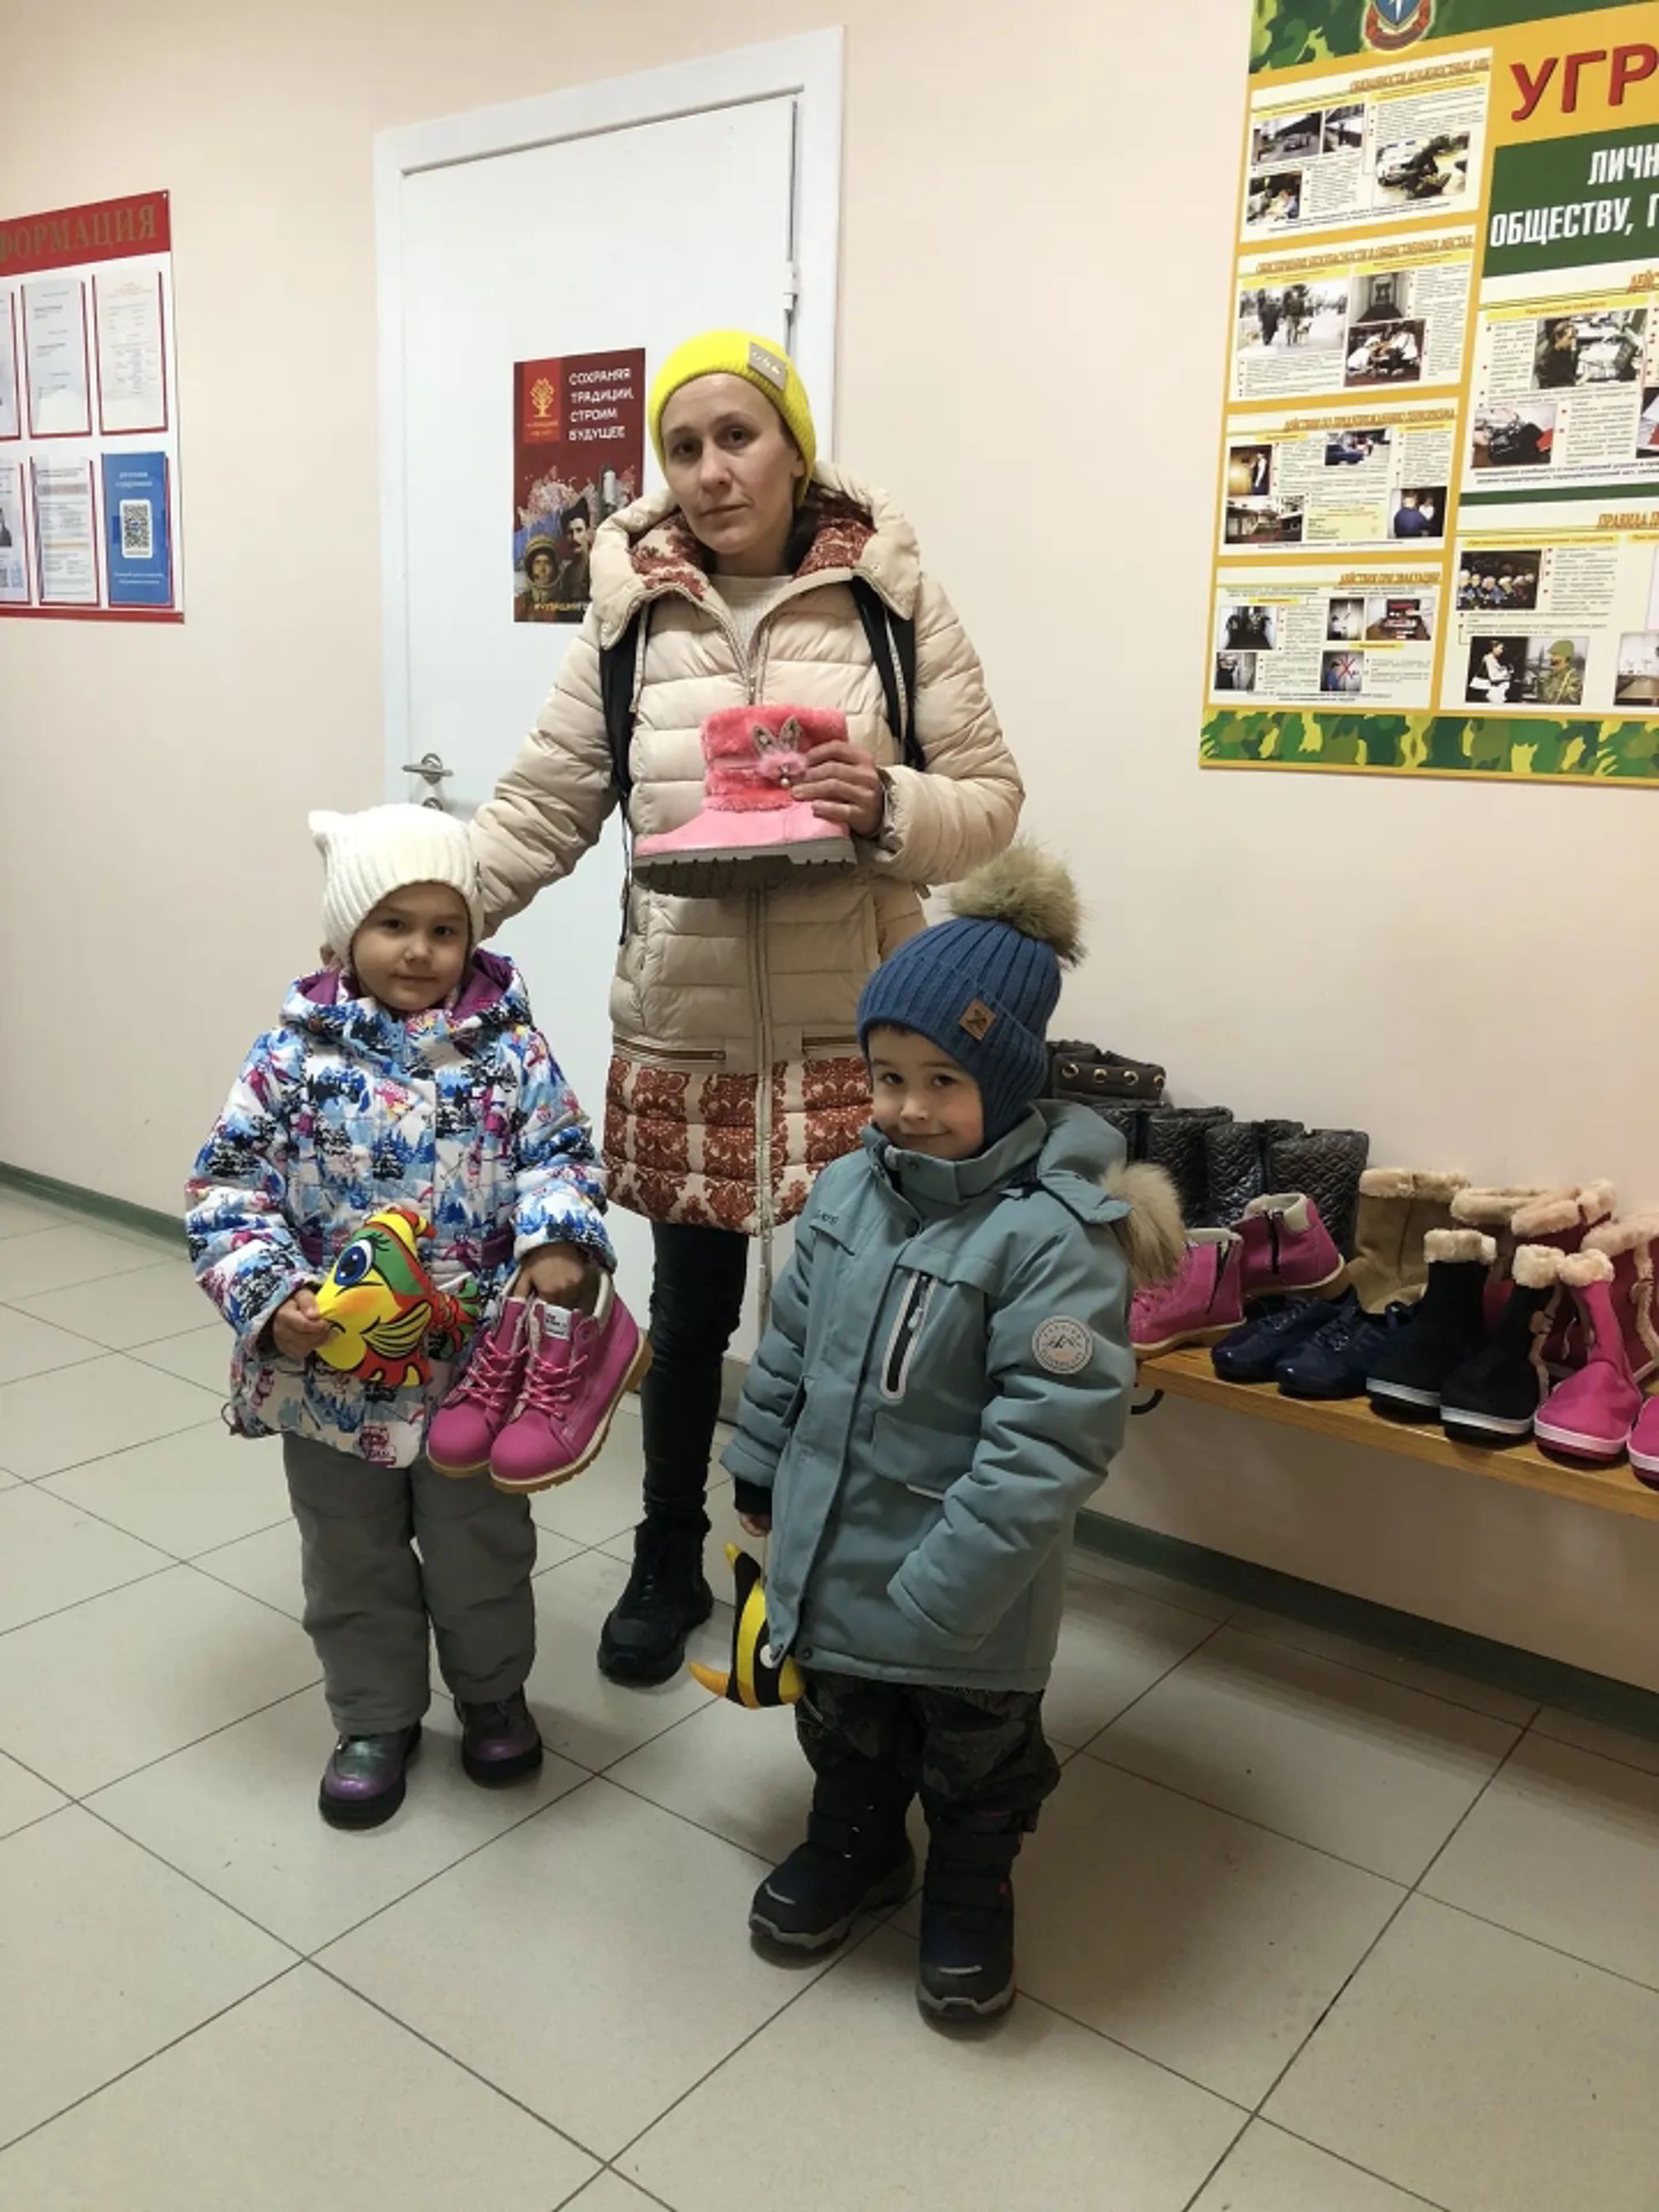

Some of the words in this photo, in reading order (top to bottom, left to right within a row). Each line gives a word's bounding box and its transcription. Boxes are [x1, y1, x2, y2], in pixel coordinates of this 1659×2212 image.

[1510, 44, 1658, 121] УГР
[1587, 142, 1659, 185] ЛИЧН
[1490, 197, 1635, 247] ОБЩЕСТВУ,
[569, 368, 631, 385] СОХРАНЯЯ
[570, 407, 618, 422] СТРОИМ
[568, 425, 625, 442] БУДУЩЕЕ
